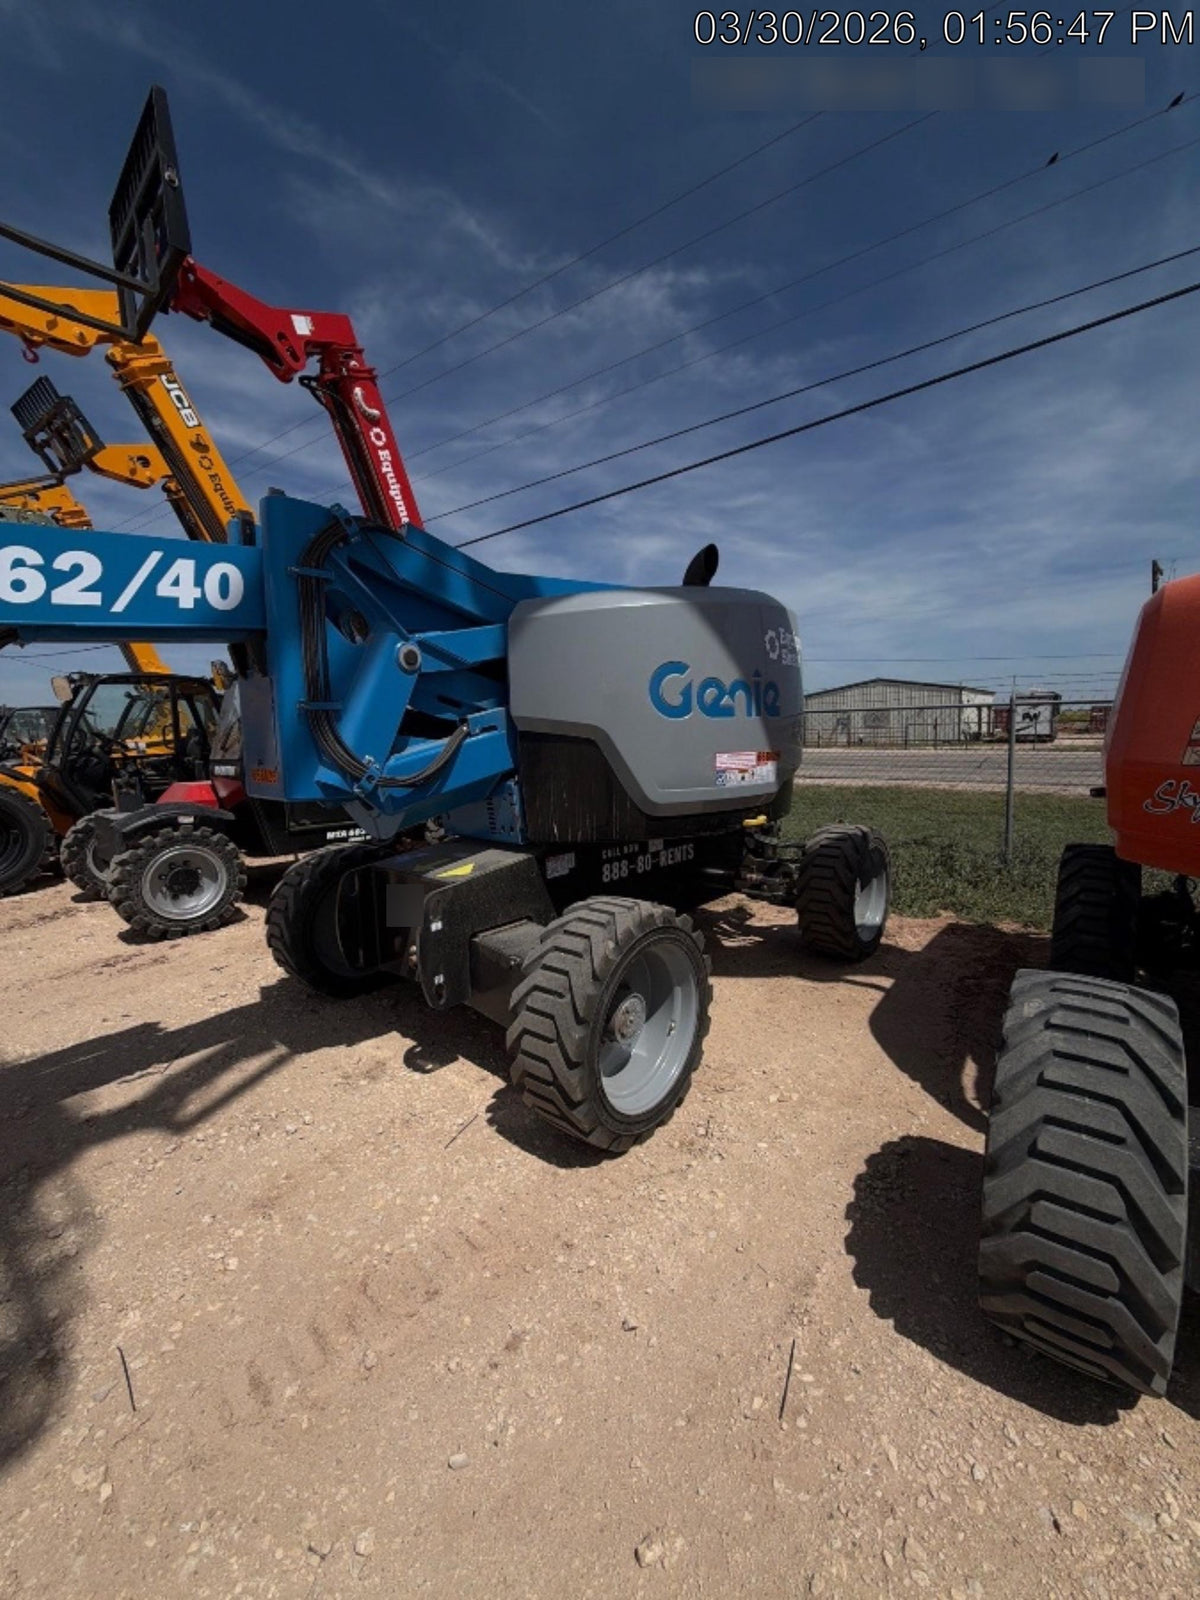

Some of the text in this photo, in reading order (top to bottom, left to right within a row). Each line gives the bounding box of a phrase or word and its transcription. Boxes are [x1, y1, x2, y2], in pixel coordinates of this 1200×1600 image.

[160, 373, 201, 427] JCB
[208, 472, 237, 519] Equip
[649, 660, 781, 719] Genie
